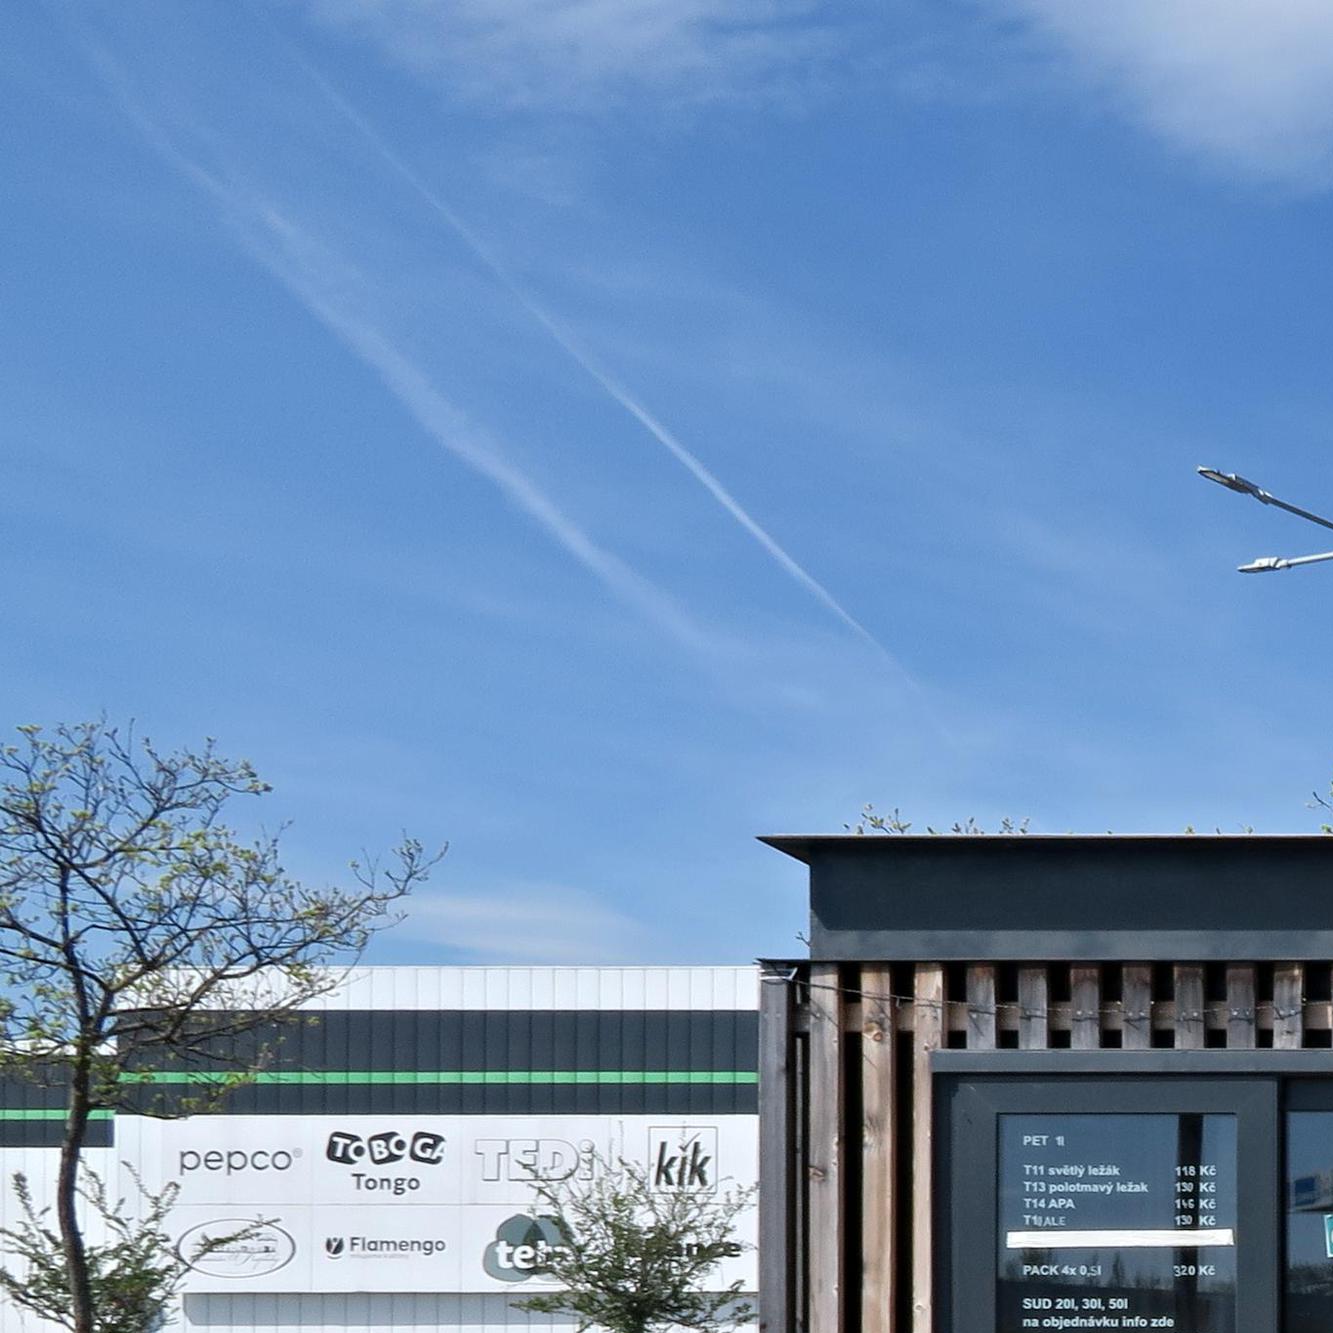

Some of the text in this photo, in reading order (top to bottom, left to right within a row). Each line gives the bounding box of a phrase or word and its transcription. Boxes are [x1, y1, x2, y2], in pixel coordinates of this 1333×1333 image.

[1023, 1135, 1049, 1146] PET
[179, 1150, 293, 1176] pepco
[475, 1138, 595, 1182] TEDi
[1023, 1164, 1044, 1176] T11
[1048, 1164, 1085, 1178] světlý
[1088, 1164, 1120, 1176] ležák
[1199, 1164, 1217, 1176] Kč
[351, 1173, 421, 1195] Tongo
[1023, 1181, 1046, 1192] T13
[1048, 1181, 1114, 1195] polotmavý
[1199, 1181, 1217, 1193] Kč
[1023, 1198, 1046, 1209] T14
[1047, 1198, 1076, 1209] APA
[1199, 1198, 1217, 1209] Kč
[1199, 1214, 1217, 1226] Kč
[350, 1236, 446, 1256] Flamengo
[1022, 1265, 1058, 1276] PACK
[1061, 1265, 1077, 1276] 4x
[1173, 1265, 1196, 1277] 320
[1198, 1264, 1216, 1276] Kč
[1022, 1298, 1052, 1309] SUD
[1022, 1316, 1175, 1330] na objednávku info zde
